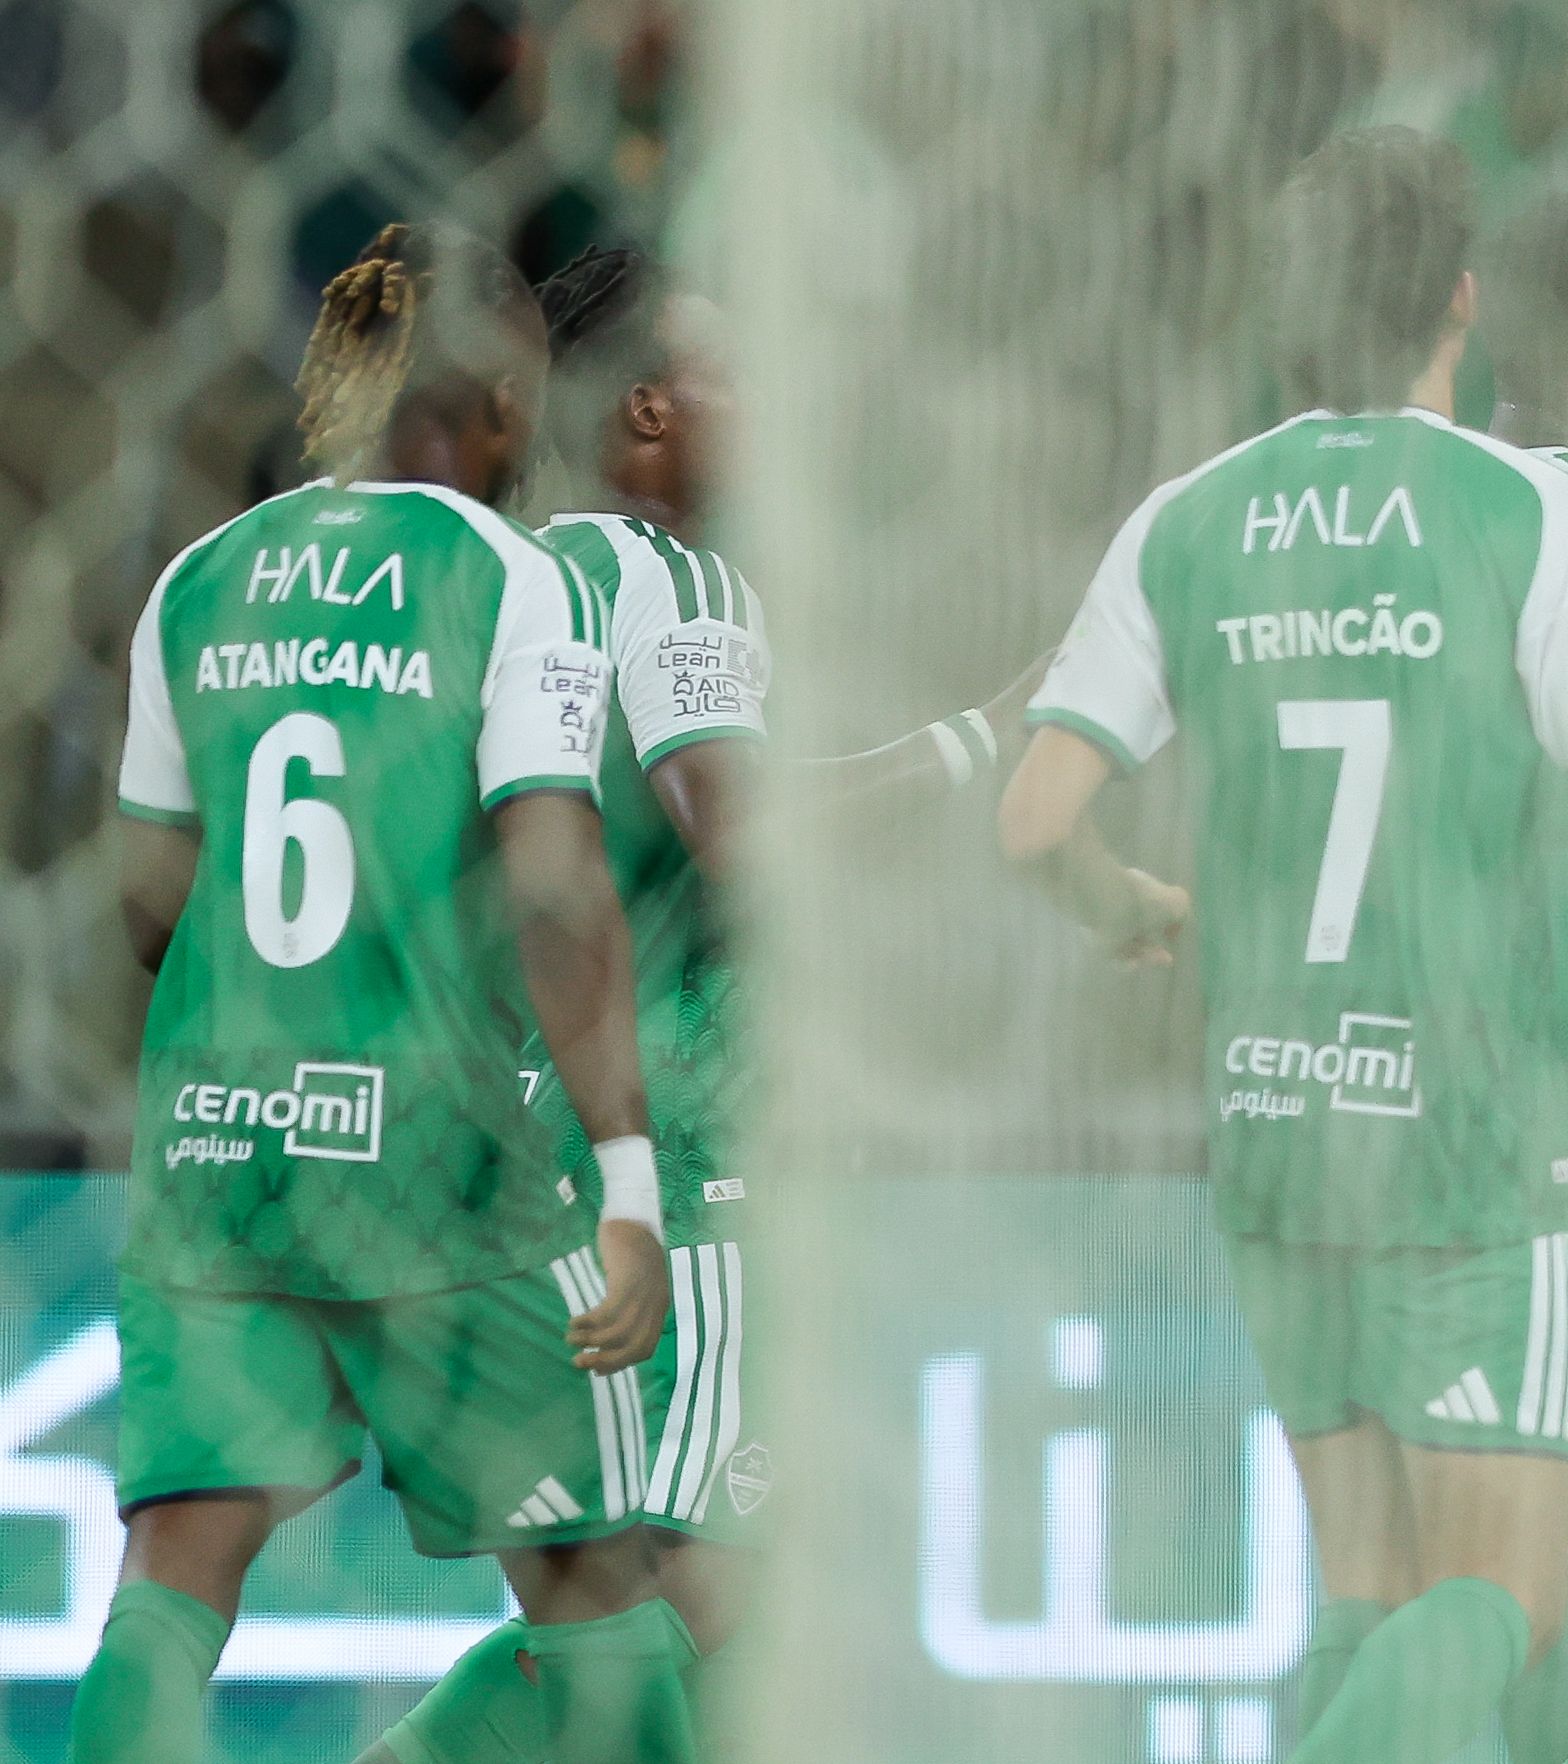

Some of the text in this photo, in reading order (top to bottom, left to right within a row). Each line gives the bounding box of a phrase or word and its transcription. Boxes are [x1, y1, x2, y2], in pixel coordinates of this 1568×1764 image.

[1243, 486, 1423, 554] HALA
[246, 543, 405, 610] HALA
[1216, 593, 1442, 664] TRINCÃO
[196, 637, 433, 699] ATANGANA
[242, 711, 356, 968] 6
[1276, 700, 1391, 963] 7
